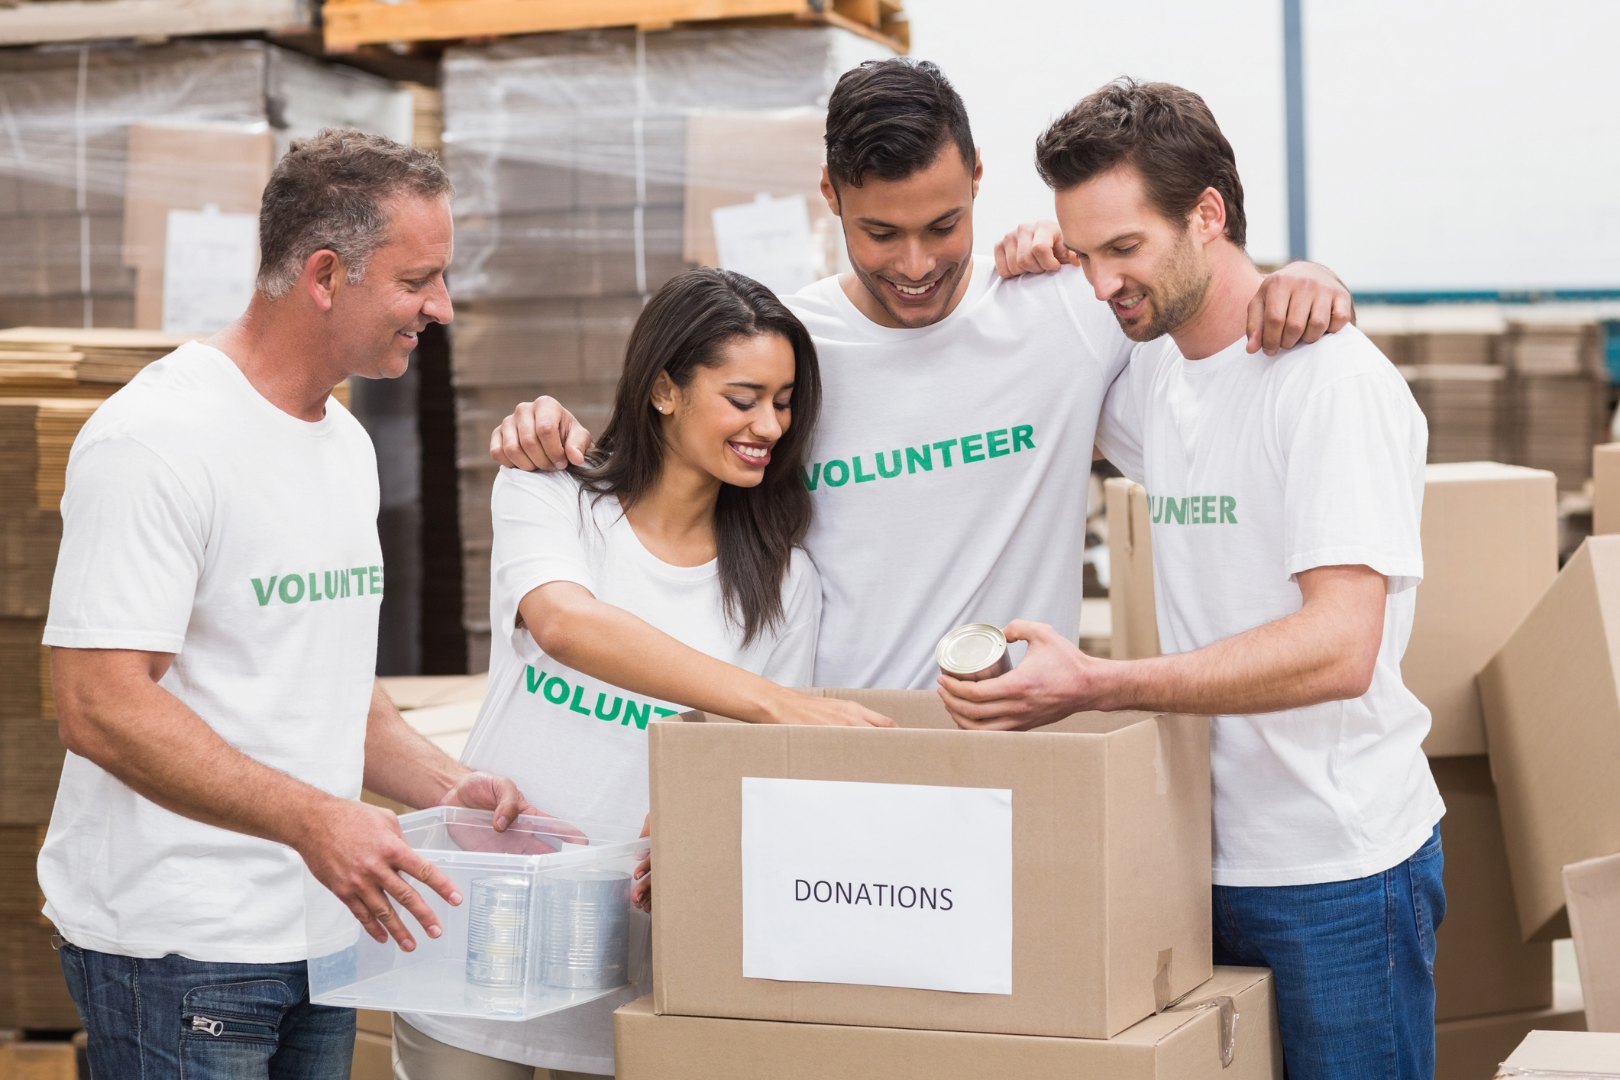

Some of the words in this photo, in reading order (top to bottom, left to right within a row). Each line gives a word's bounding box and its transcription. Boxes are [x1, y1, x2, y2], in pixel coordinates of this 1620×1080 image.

[801, 424, 1036, 492] VOLUNTEER
[250, 565, 384, 607] VOLUNTE
[794, 879, 953, 911] DONATIONS
